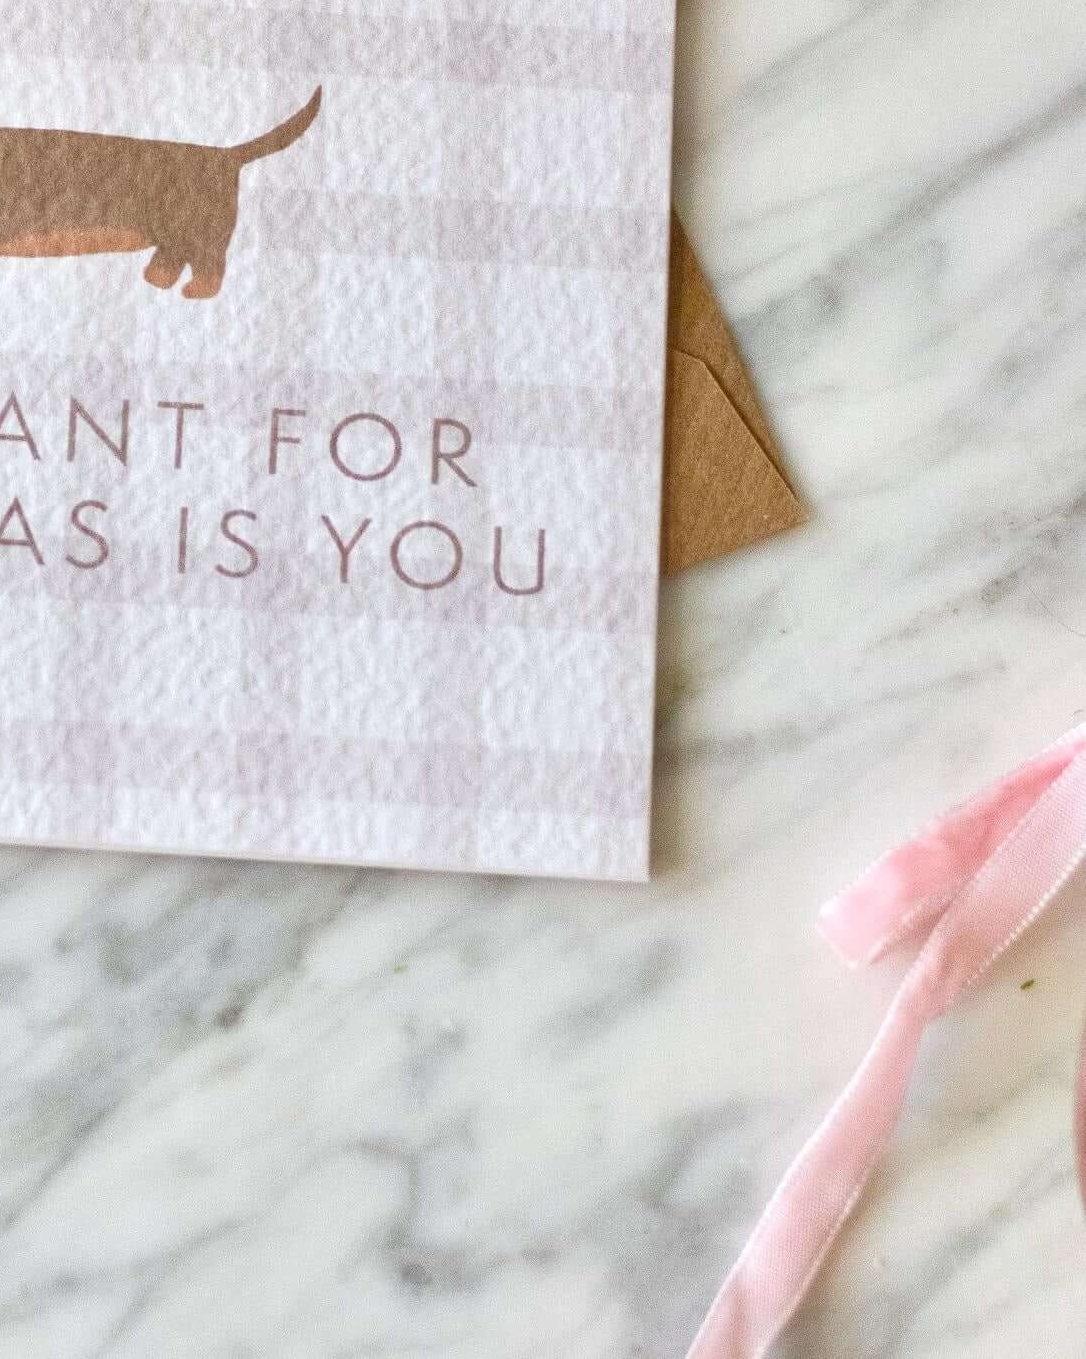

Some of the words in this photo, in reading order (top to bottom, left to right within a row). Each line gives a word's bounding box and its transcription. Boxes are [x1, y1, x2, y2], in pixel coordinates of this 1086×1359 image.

[268, 407, 478, 488] FOR
[177, 506, 261, 579] IS
[321, 515, 546, 596] YOU
